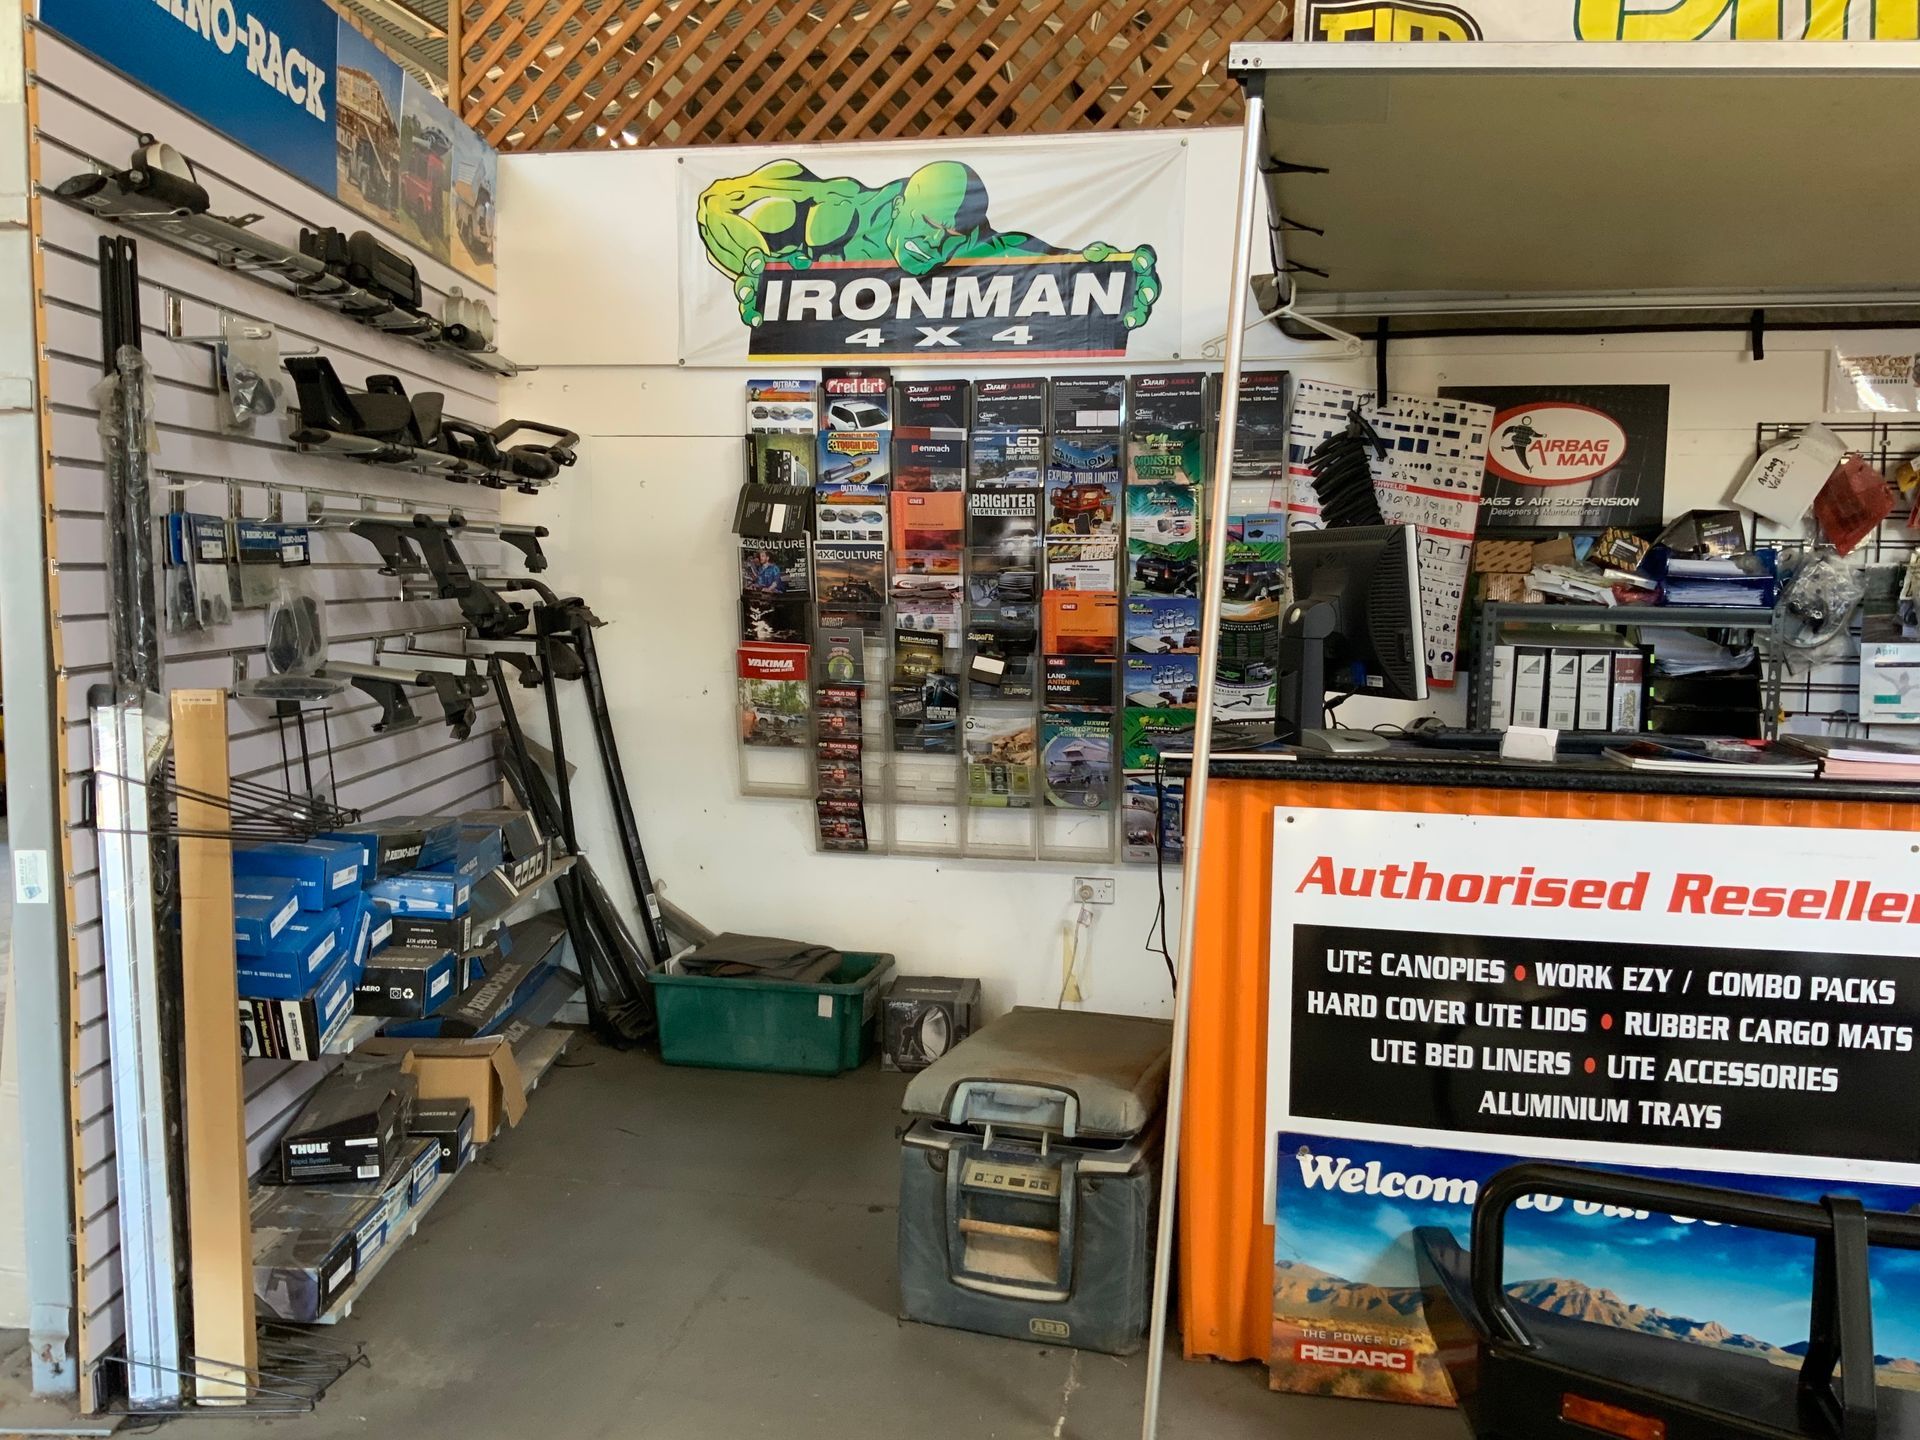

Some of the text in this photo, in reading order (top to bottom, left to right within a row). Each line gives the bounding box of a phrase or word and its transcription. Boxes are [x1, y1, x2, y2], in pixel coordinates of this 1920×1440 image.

[763, 272, 1127, 322] IRONMAN
[837, 378, 884, 393] red dirt
[836, 441, 878, 450] TOUGH DOG
[1006, 437, 1040, 446] LED
[1528, 440, 1610, 466] AIRBAG
[1134, 455, 1182, 466] MONSTER
[1556, 454, 1606, 466] MAN
[1048, 470, 1118, 484] EXPLORE YOUR LIMITS!
[972, 494, 1035, 508] BRIGHTER
[1515, 498, 1524, 506] &
[1528, 498, 1550, 506] AIR
[1554, 498, 1639, 506] SUSPENSION
[1490, 508, 1532, 516] Designers
[1542, 508, 1600, 516] Manufacturers
[759, 540, 805, 549] CULTURE
[837, 551, 883, 559] CULTURE
[1080, 552, 1114, 560] RELEASE
[1875, 647, 1899, 656] April
[748, 658, 794, 667] YAKIMA
[1296, 856, 1650, 911] Authorised
[1328, 949, 1371, 974] UTE
[1381, 953, 1505, 984] CANOPIES
[1536, 962, 1612, 990] WORK
[1623, 967, 1672, 992] EZY
[1708, 972, 1801, 1000] COMBO
[1811, 977, 1896, 1004] PACKS
[1308, 990, 1912, 1052] HARD COVER UTE LIDS RUBBER CARGO MATS
[1371, 1038, 1838, 1092] UTE BED LINERS UTE ACCESSORIES
[1478, 1090, 1722, 1128] ALUMINIUM TRAYS
[290, 1143, 329, 1154] THULE
[309, 1157, 330, 1165] System
[1296, 1154, 1478, 1205] Welcom
[1034, 1322, 1066, 1335] ARB
[1302, 1328, 1408, 1346] THE POWER OF
[1300, 1344, 1406, 1369] REDARC
